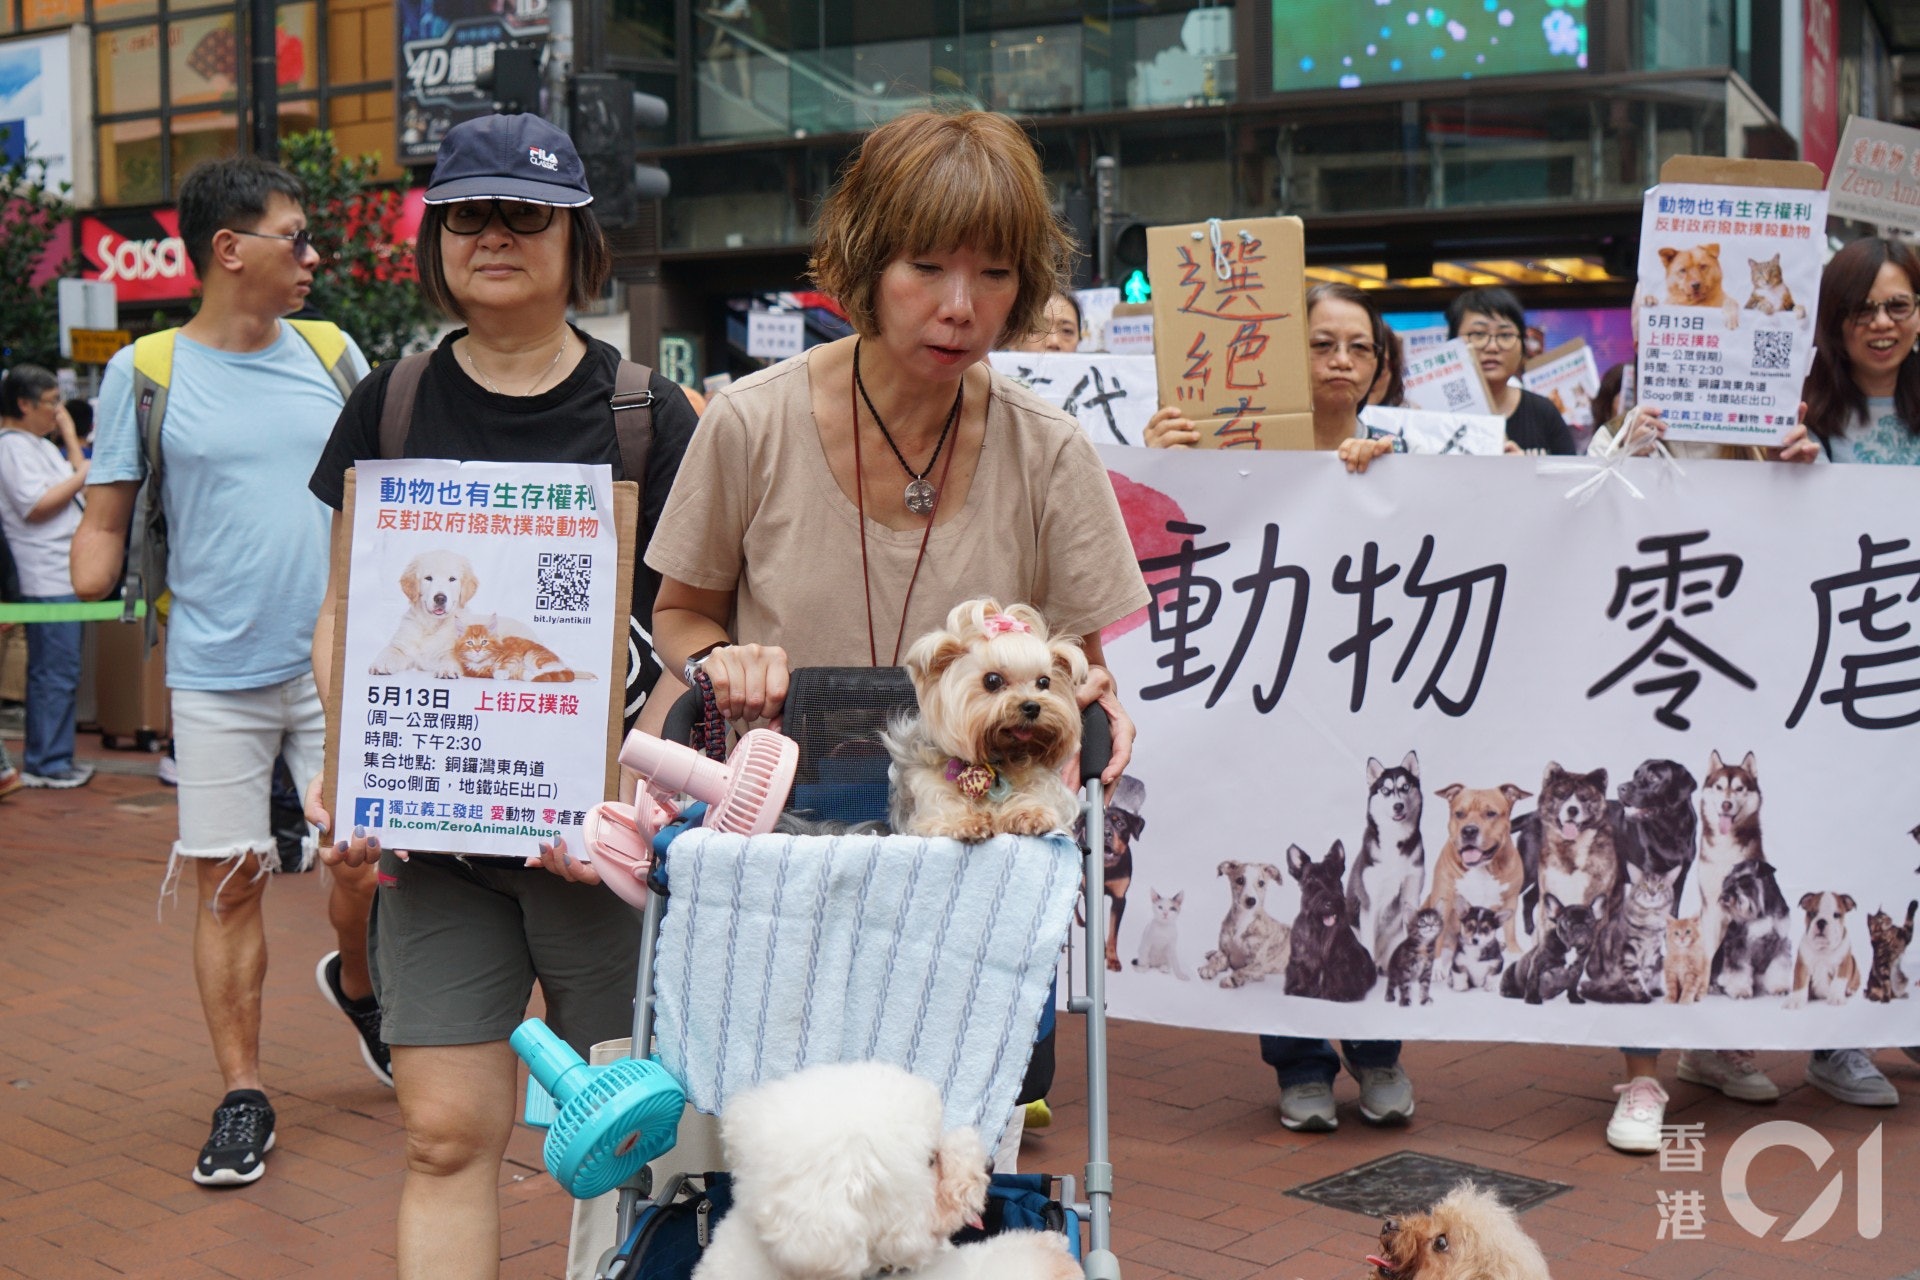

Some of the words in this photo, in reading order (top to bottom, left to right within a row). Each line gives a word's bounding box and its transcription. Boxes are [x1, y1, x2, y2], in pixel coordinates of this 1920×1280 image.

[529, 146, 559, 164] FILA
[529, 156, 559, 171] CLASSIC
[1841, 167, 1884, 198] Zero
[1658, 196, 1812, 221] 動物也有生存權利
[1655, 217, 1811, 239] 反對政府撥款撲殺動物
[1648, 315, 1704, 330] 5月13日
[1647, 332, 1720, 348] 上街反撲殺
[1646, 347, 1723, 363] (周一公眾假期)
[1643, 362, 1669, 374] 時間:
[1677, 364, 1724, 376] 下午2:30
[1643, 375, 1692, 388] 集合地點:
[1697, 378, 1767, 392] 銅鑼灣東角道
[1668, 422, 1777, 434] .com/ZeroAnimalAbuse
[380, 477, 597, 511] 動物也有生存權利
[376, 509, 599, 539] 反對政府撥款撲殺動物
[533, 615, 592, 625] bit.ly/antikill
[1138, 519, 1508, 718] 動物
[367, 686, 450, 709] 5月13日
[474, 690, 580, 715] 上街反撲殺
[367, 709, 479, 731] (周一公眾假期)
[364, 731, 403, 748] 時間:
[412, 733, 482, 751] 下午2:30
[364, 751, 436, 771] 集合地點:
[445, 756, 545, 777] 銅鑼灣東角道
[389, 800, 484, 820] 獨立義工發起
[490, 805, 536, 823] 愛動物
[542, 808, 587, 826] 零虐畜
[389, 820, 561, 838] fb.com/ZeroAnimalAbuse
